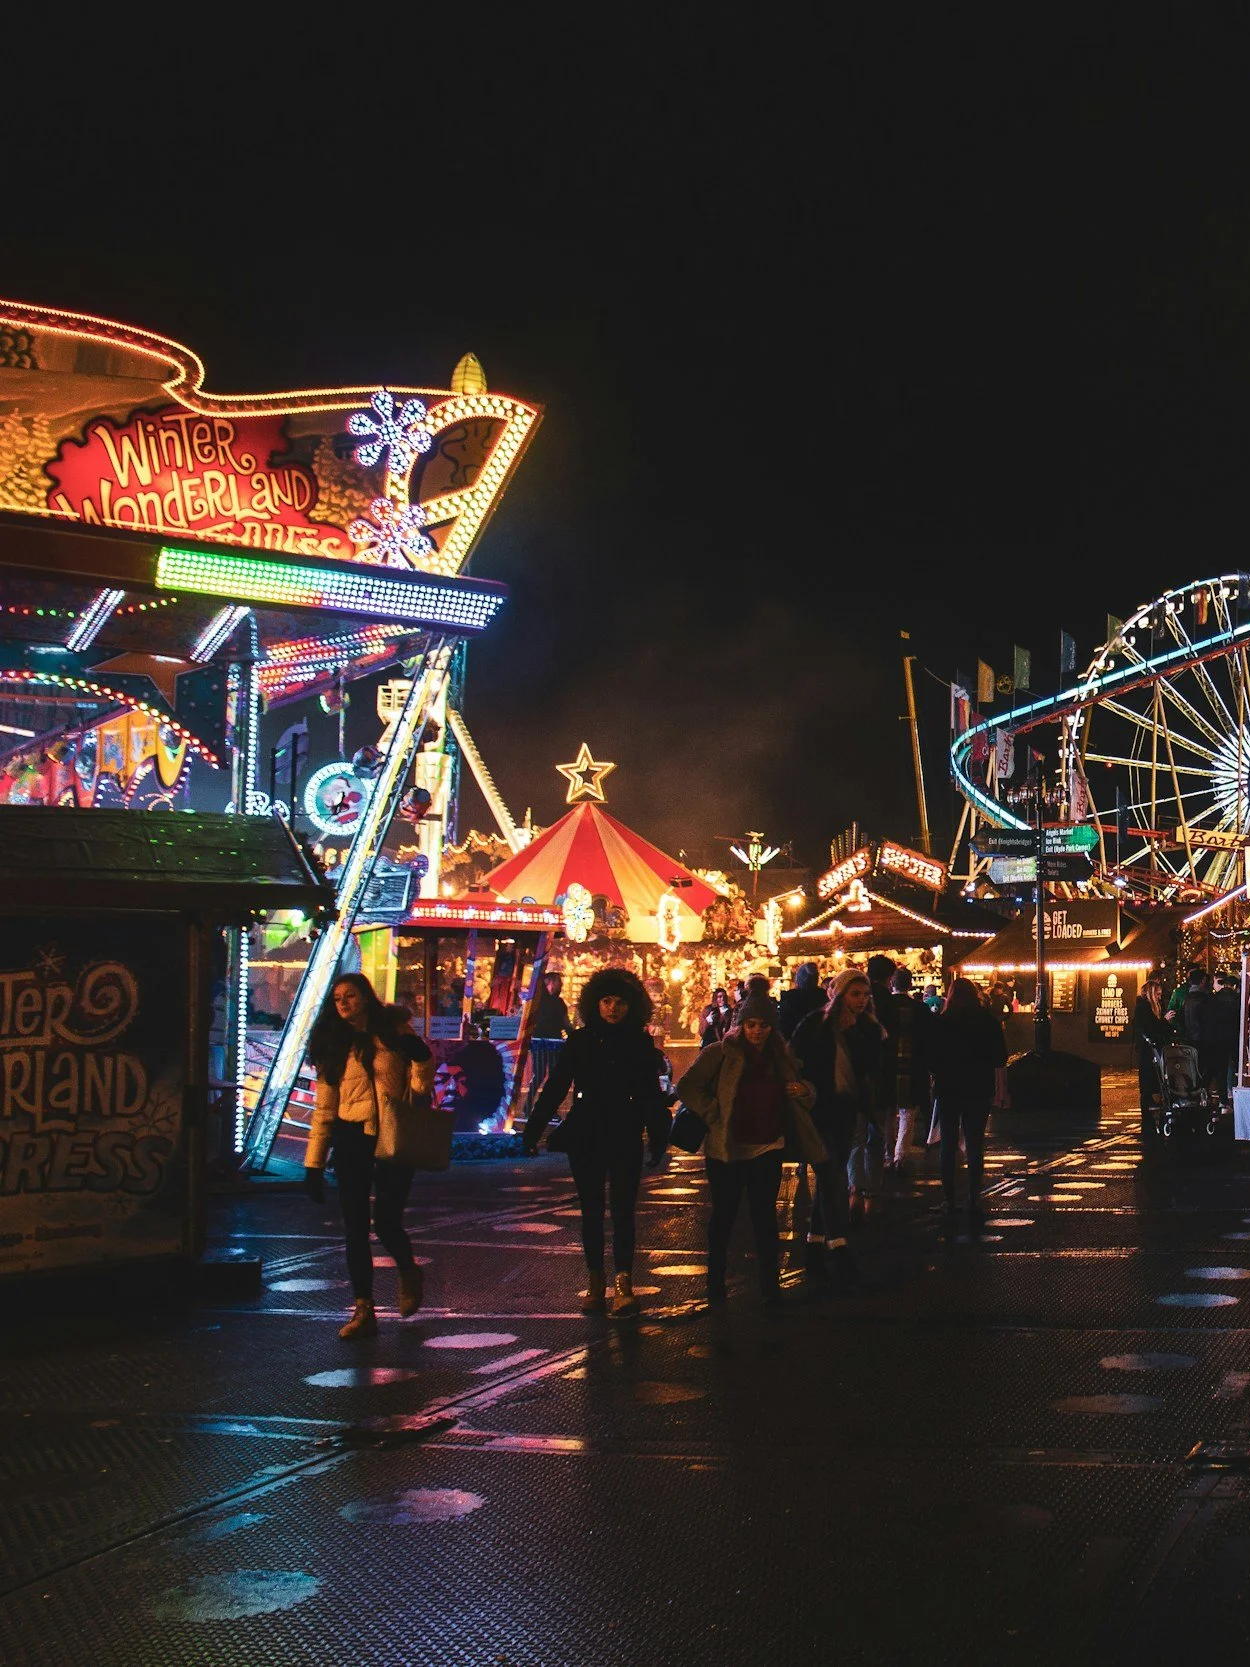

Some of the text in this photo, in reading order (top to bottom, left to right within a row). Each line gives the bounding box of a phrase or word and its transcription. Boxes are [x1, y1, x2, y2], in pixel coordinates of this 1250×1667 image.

[1052, 910, 1068, 925] GET
[1052, 924, 1083, 939] LOADED
[1101, 988, 1123, 997] LOAD UP
